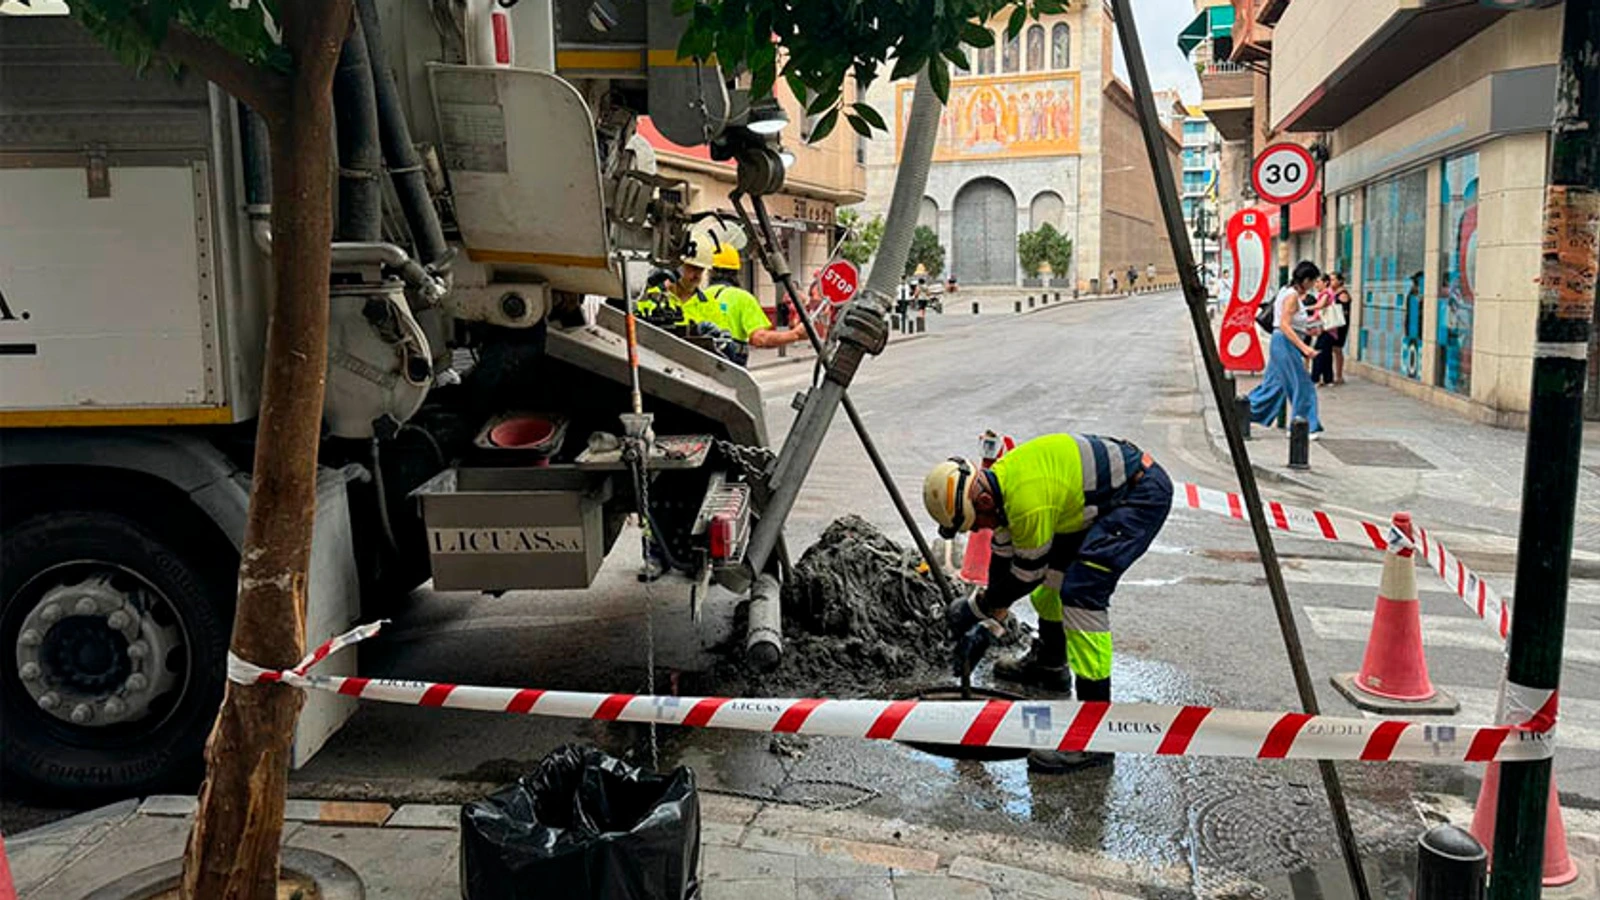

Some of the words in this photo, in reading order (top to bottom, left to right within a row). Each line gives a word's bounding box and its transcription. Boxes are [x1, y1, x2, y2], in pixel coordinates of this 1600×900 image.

[1265, 162, 1301, 185] 30
[825, 269, 853, 294] STOP
[731, 702, 780, 712] LICUAS
[1108, 720, 1162, 733] LICUAS
